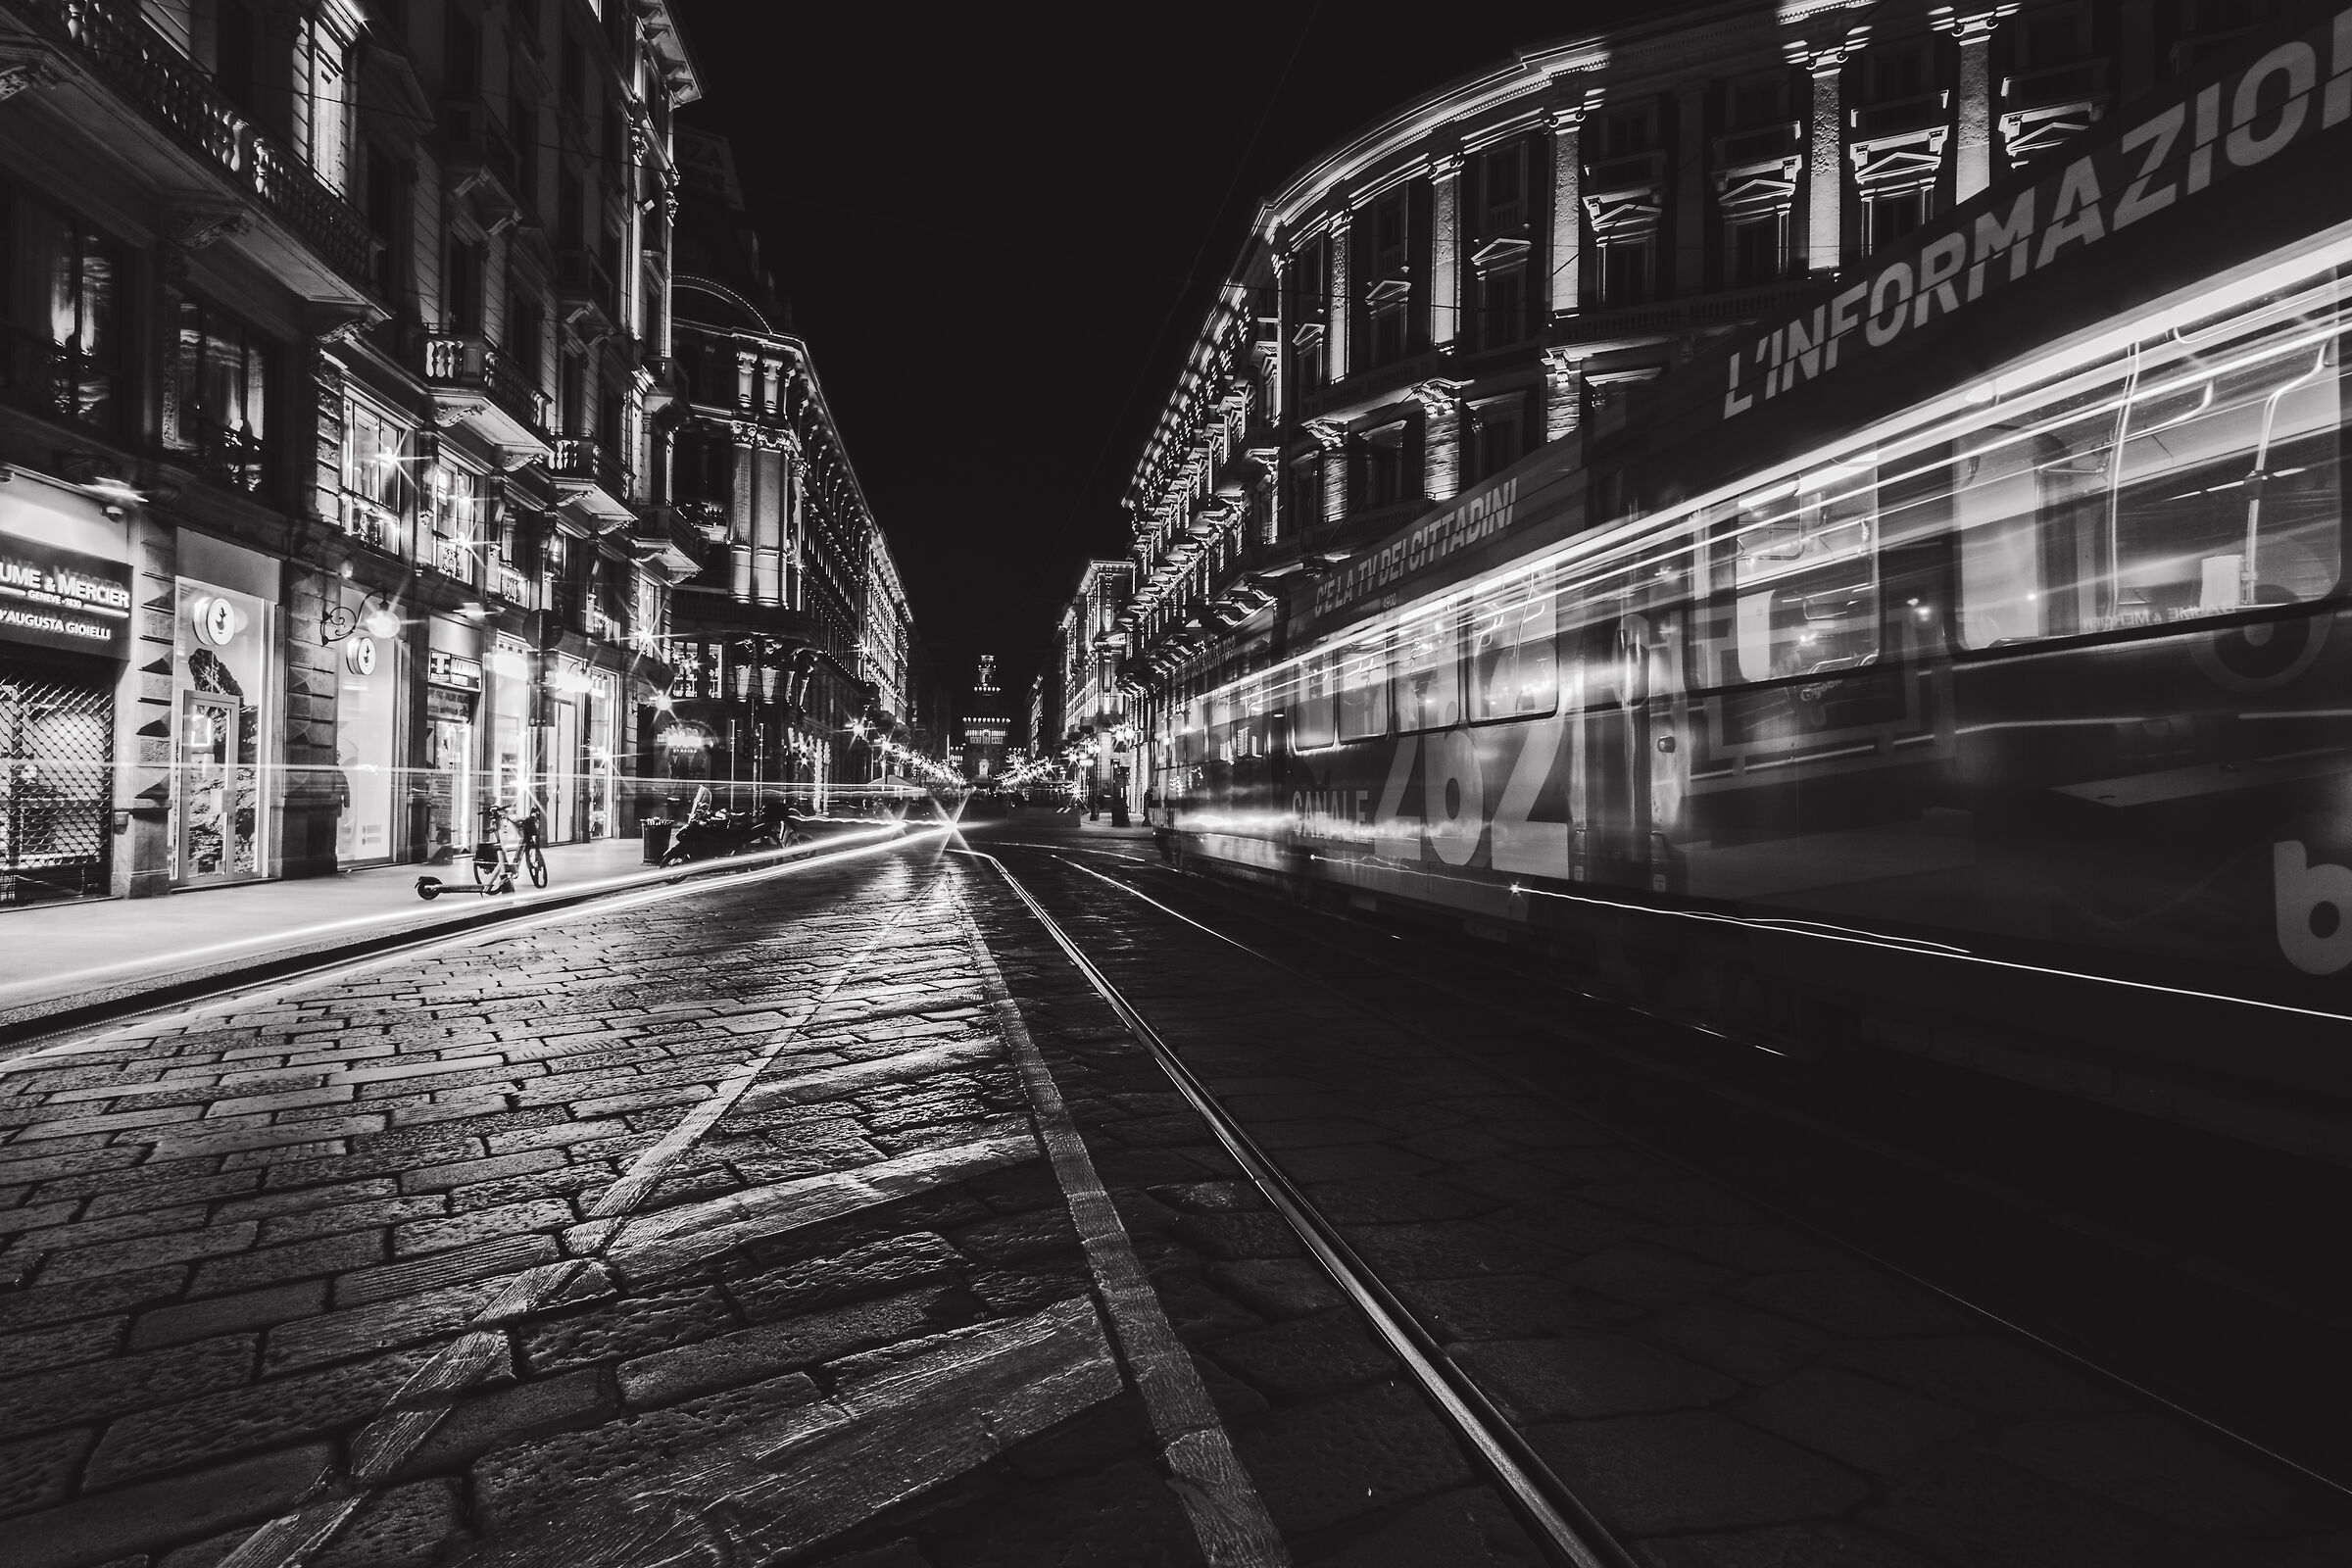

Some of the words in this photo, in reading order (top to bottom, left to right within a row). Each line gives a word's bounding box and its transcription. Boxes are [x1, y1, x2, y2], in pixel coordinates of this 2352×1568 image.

[1335, 568, 1352, 610] LA
[1358, 554, 1378, 597] TV
[1378, 538, 1407, 588] DEI
[1408, 476, 1518, 572] CITTADINI
[44, 576, 56, 592] &
[57, 572, 130, 609] MERCIER
[65, 621, 111, 641] GIOIELLI
[1293, 791, 1370, 844] CANALE
